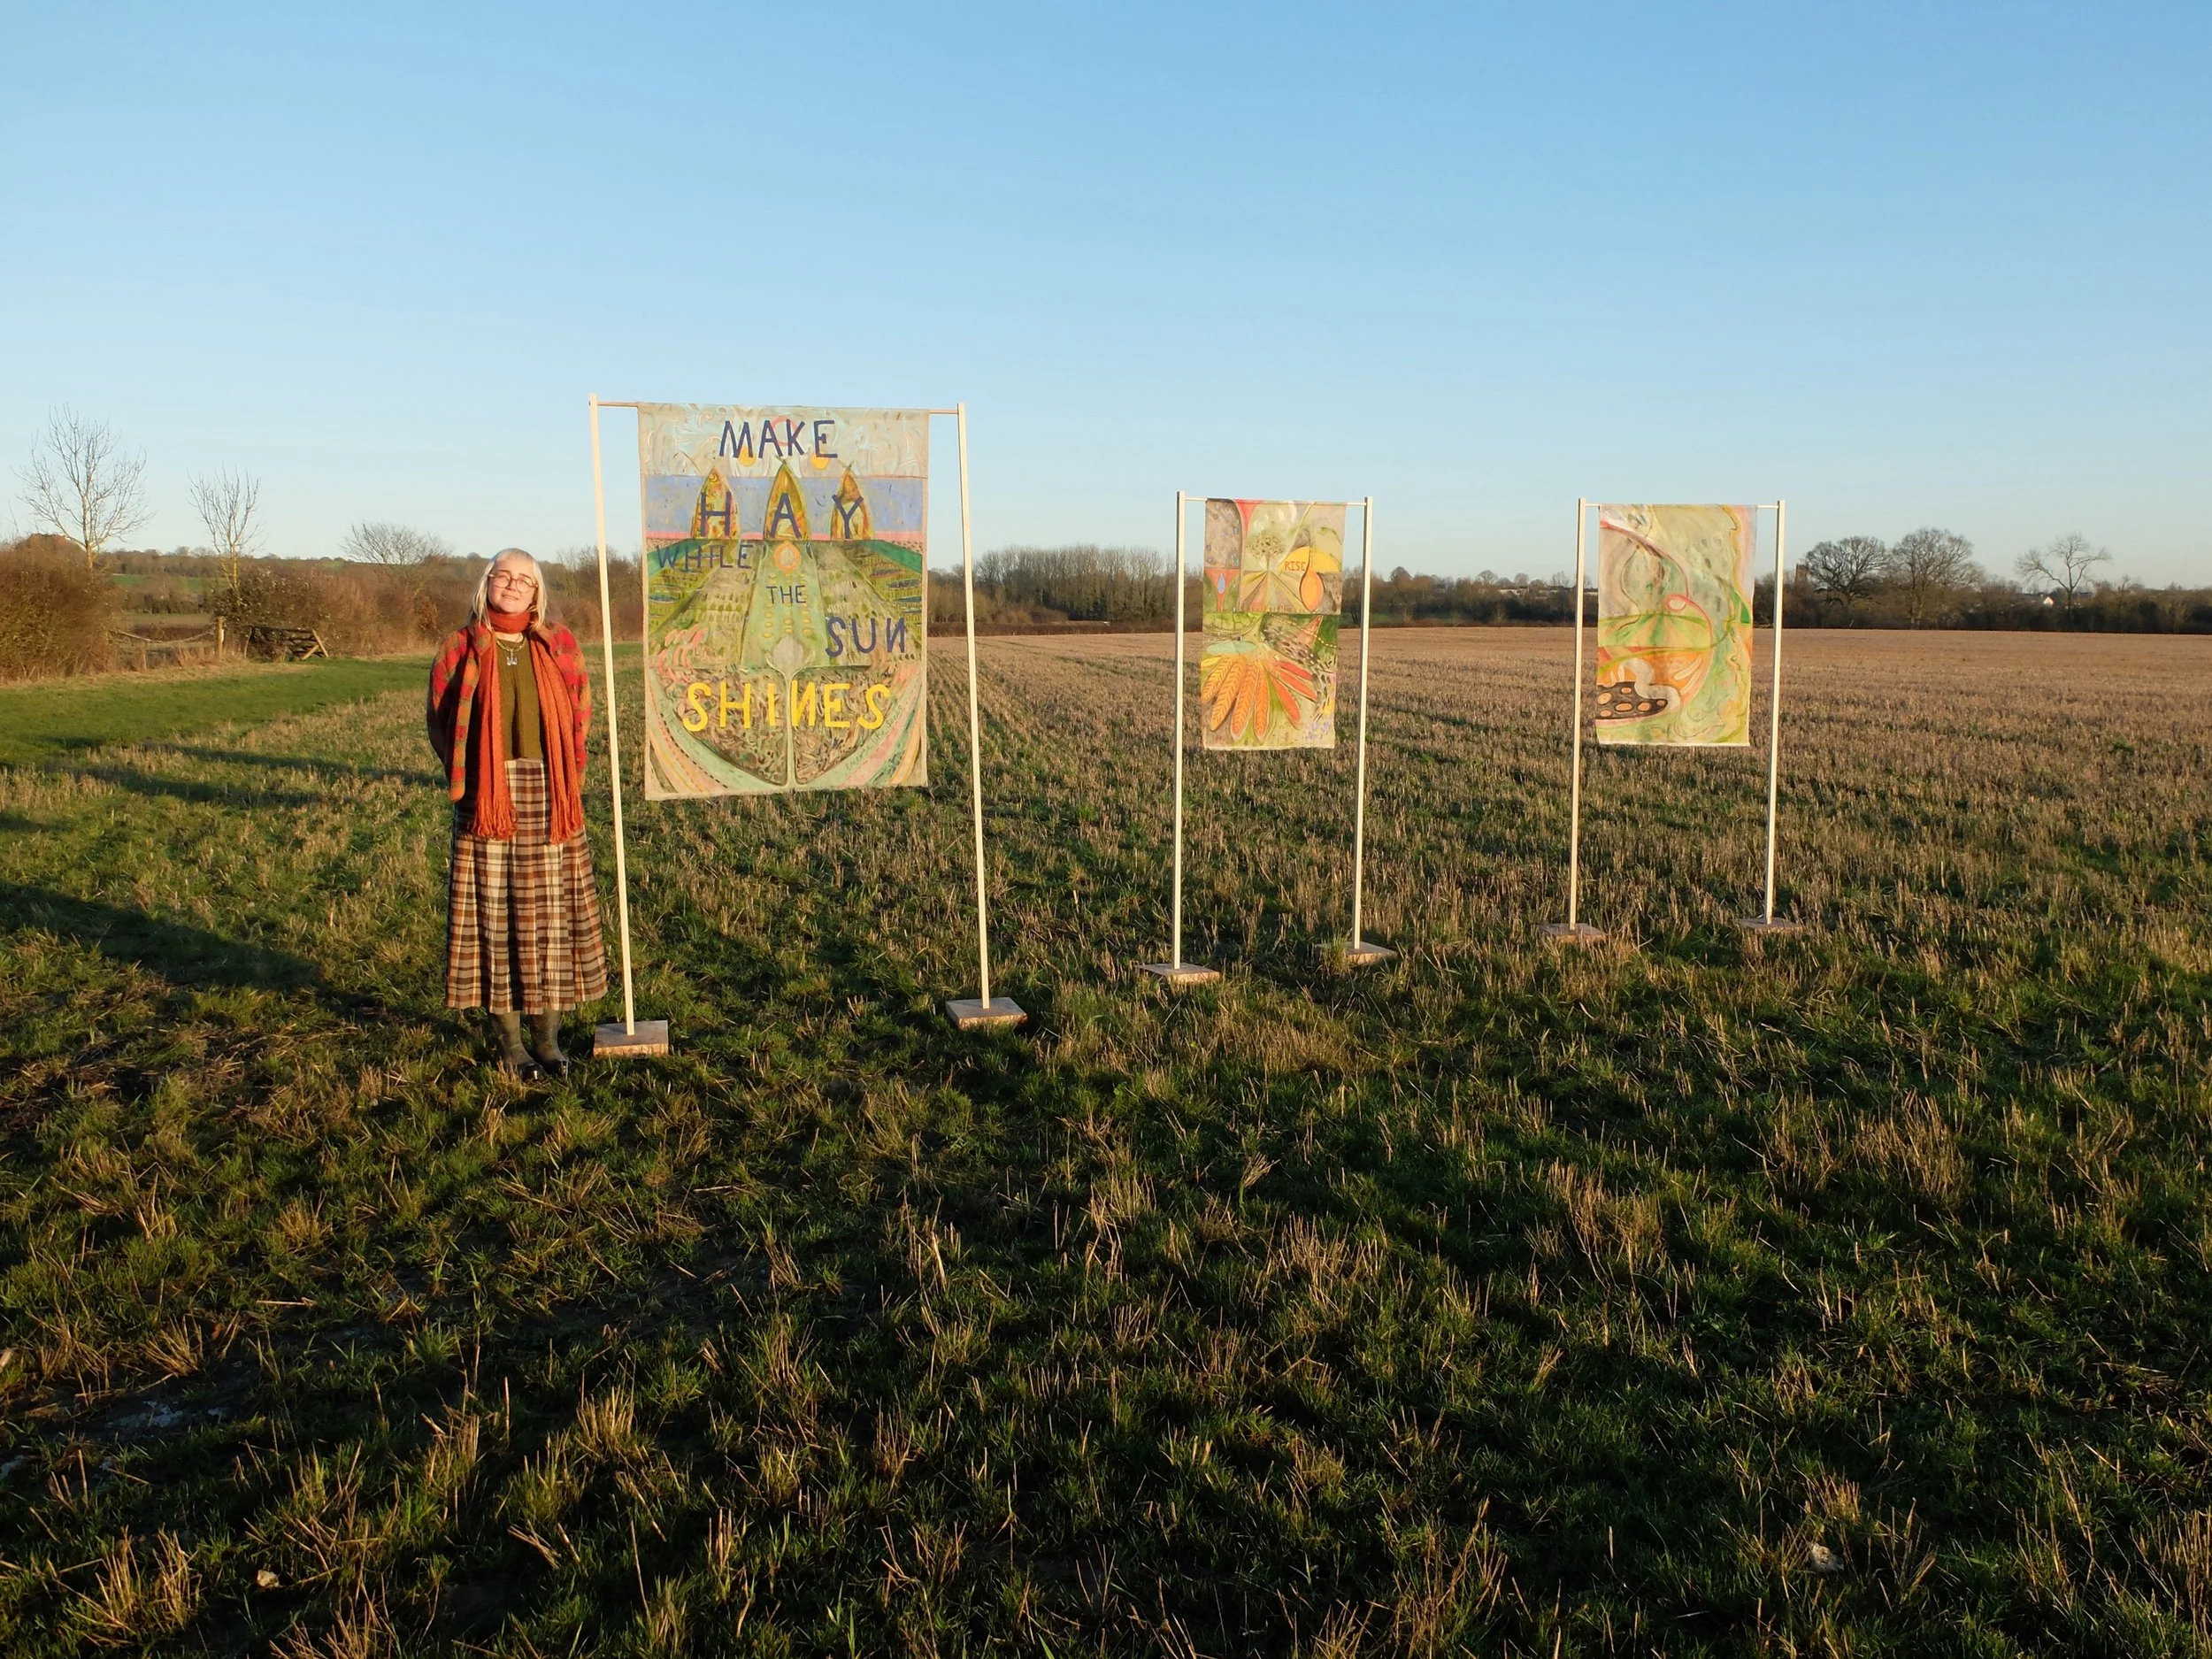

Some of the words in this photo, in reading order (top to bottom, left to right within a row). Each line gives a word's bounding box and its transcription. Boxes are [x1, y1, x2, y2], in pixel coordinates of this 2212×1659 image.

[718, 419, 838, 459] MAKE
[701, 490, 864, 540] HAY
[656, 544, 753, 571] WHILE
[766, 585, 807, 604] THE
[825, 617, 906, 657] SUN
[682, 680, 891, 732] SHINES
